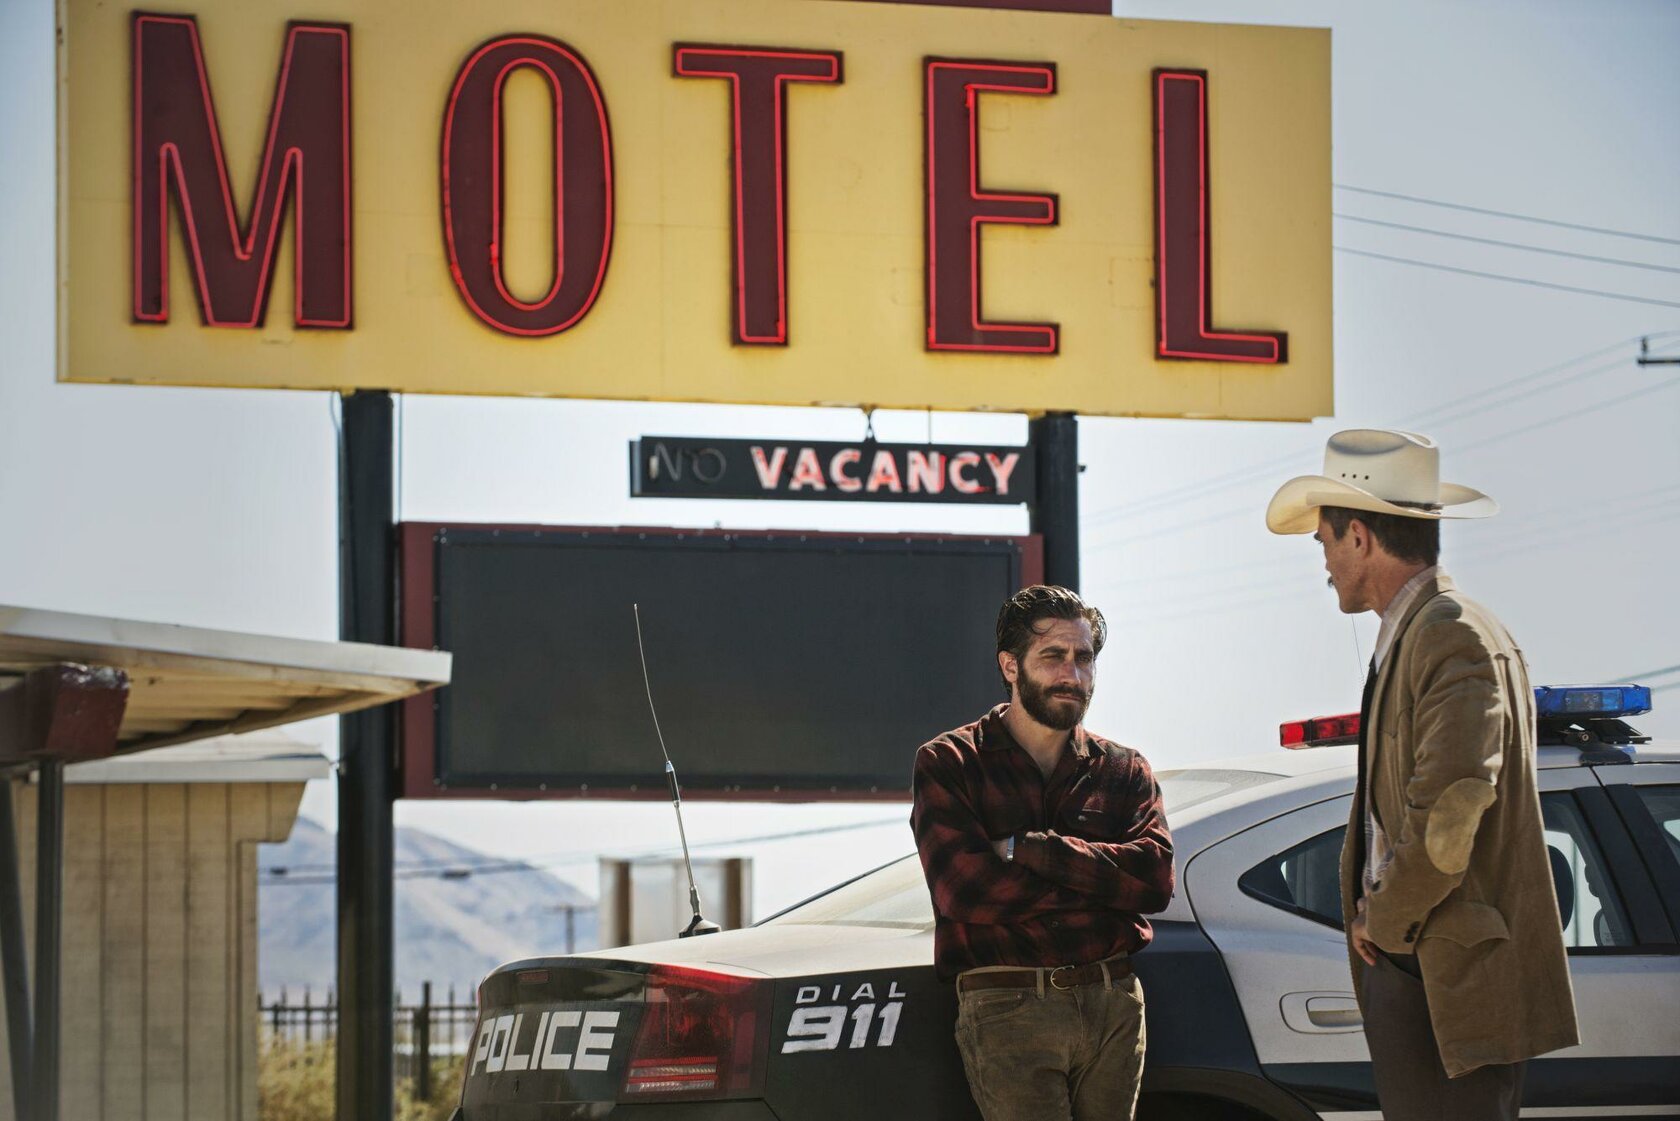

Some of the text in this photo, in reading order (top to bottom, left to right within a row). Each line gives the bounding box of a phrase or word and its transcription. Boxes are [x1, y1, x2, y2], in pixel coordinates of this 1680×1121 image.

[132, 11, 1288, 363] MOTEL
[651, 442, 1020, 495] NO VACANCY
[796, 981, 907, 1004] DIAL
[471, 1010, 621, 1077] POLICE
[781, 1002, 904, 1054] 911
